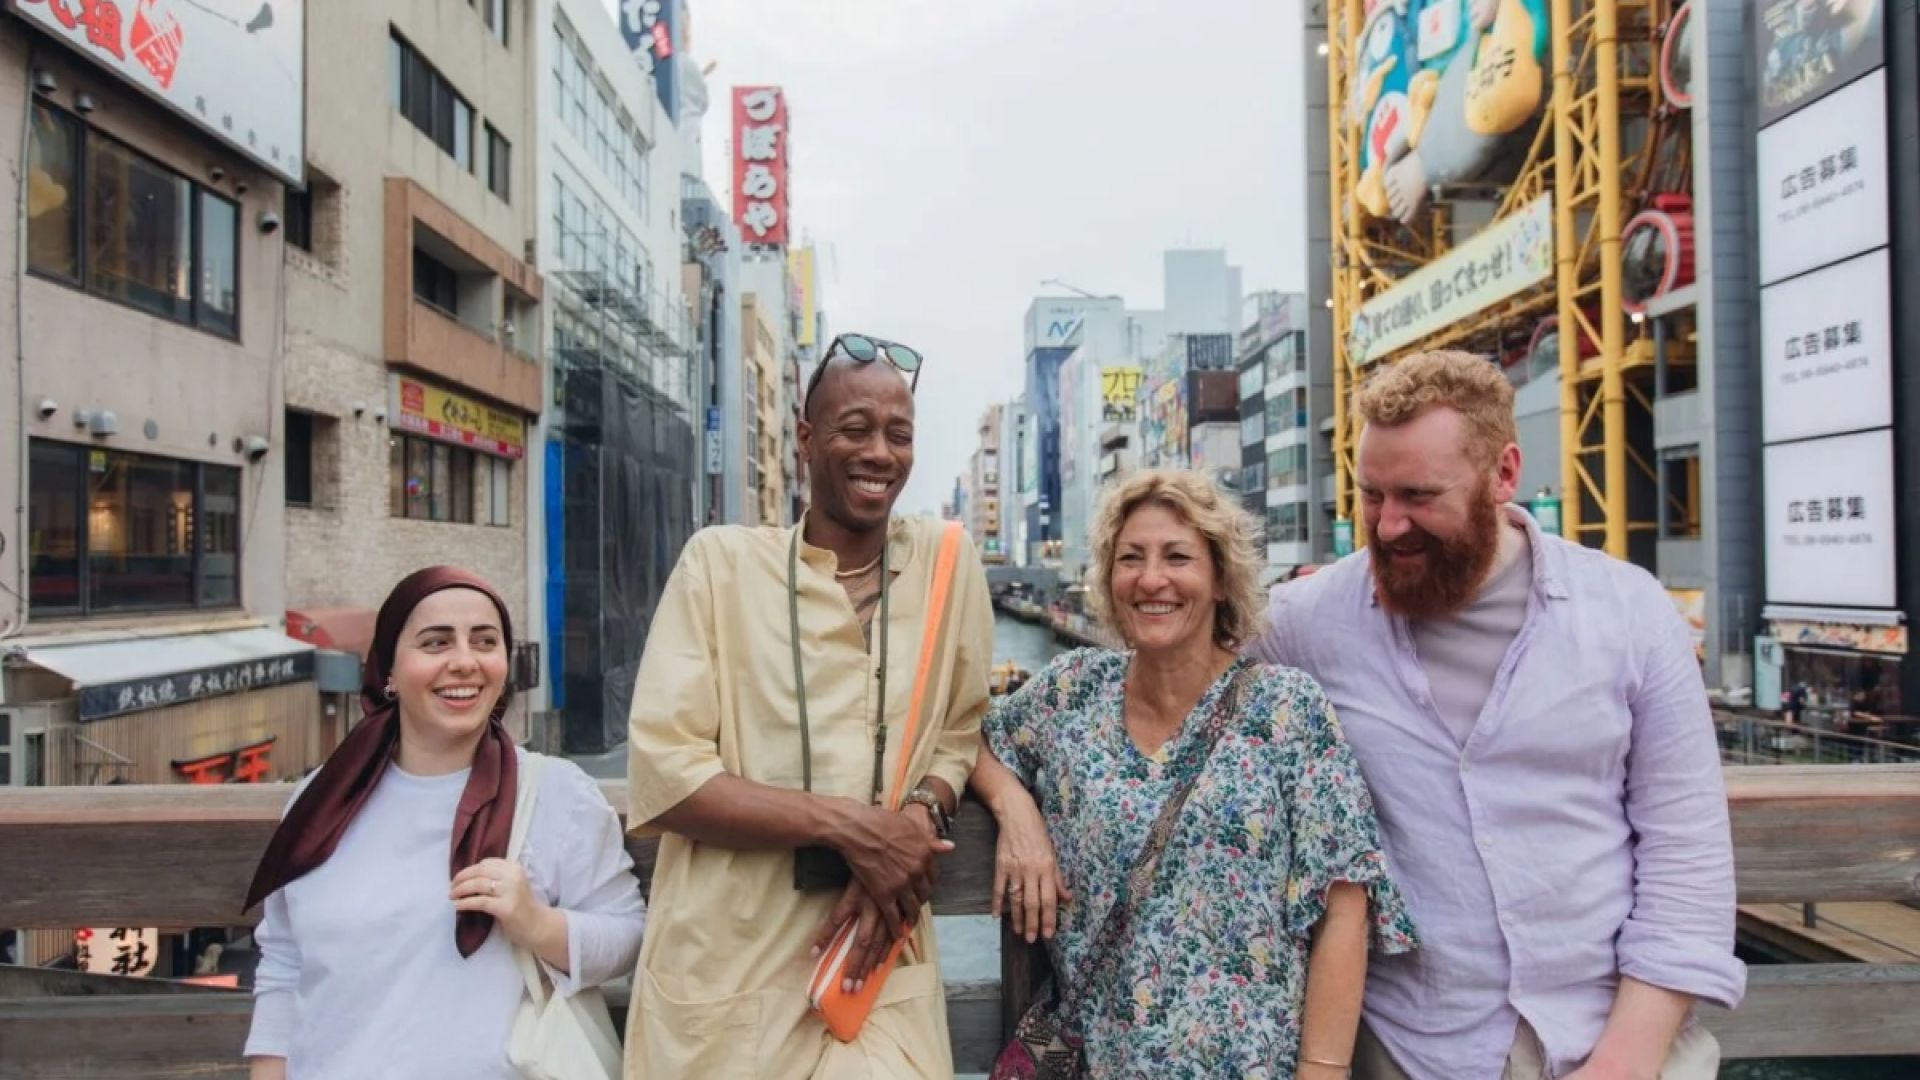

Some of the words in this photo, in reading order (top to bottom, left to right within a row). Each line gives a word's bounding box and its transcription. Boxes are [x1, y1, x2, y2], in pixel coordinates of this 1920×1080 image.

[742, 87, 782, 238] づぼらや
[1781, 146, 1858, 199] 広告募集
[1784, 320, 1861, 360] 広告募集
[1787, 496, 1864, 523] 広告募集
